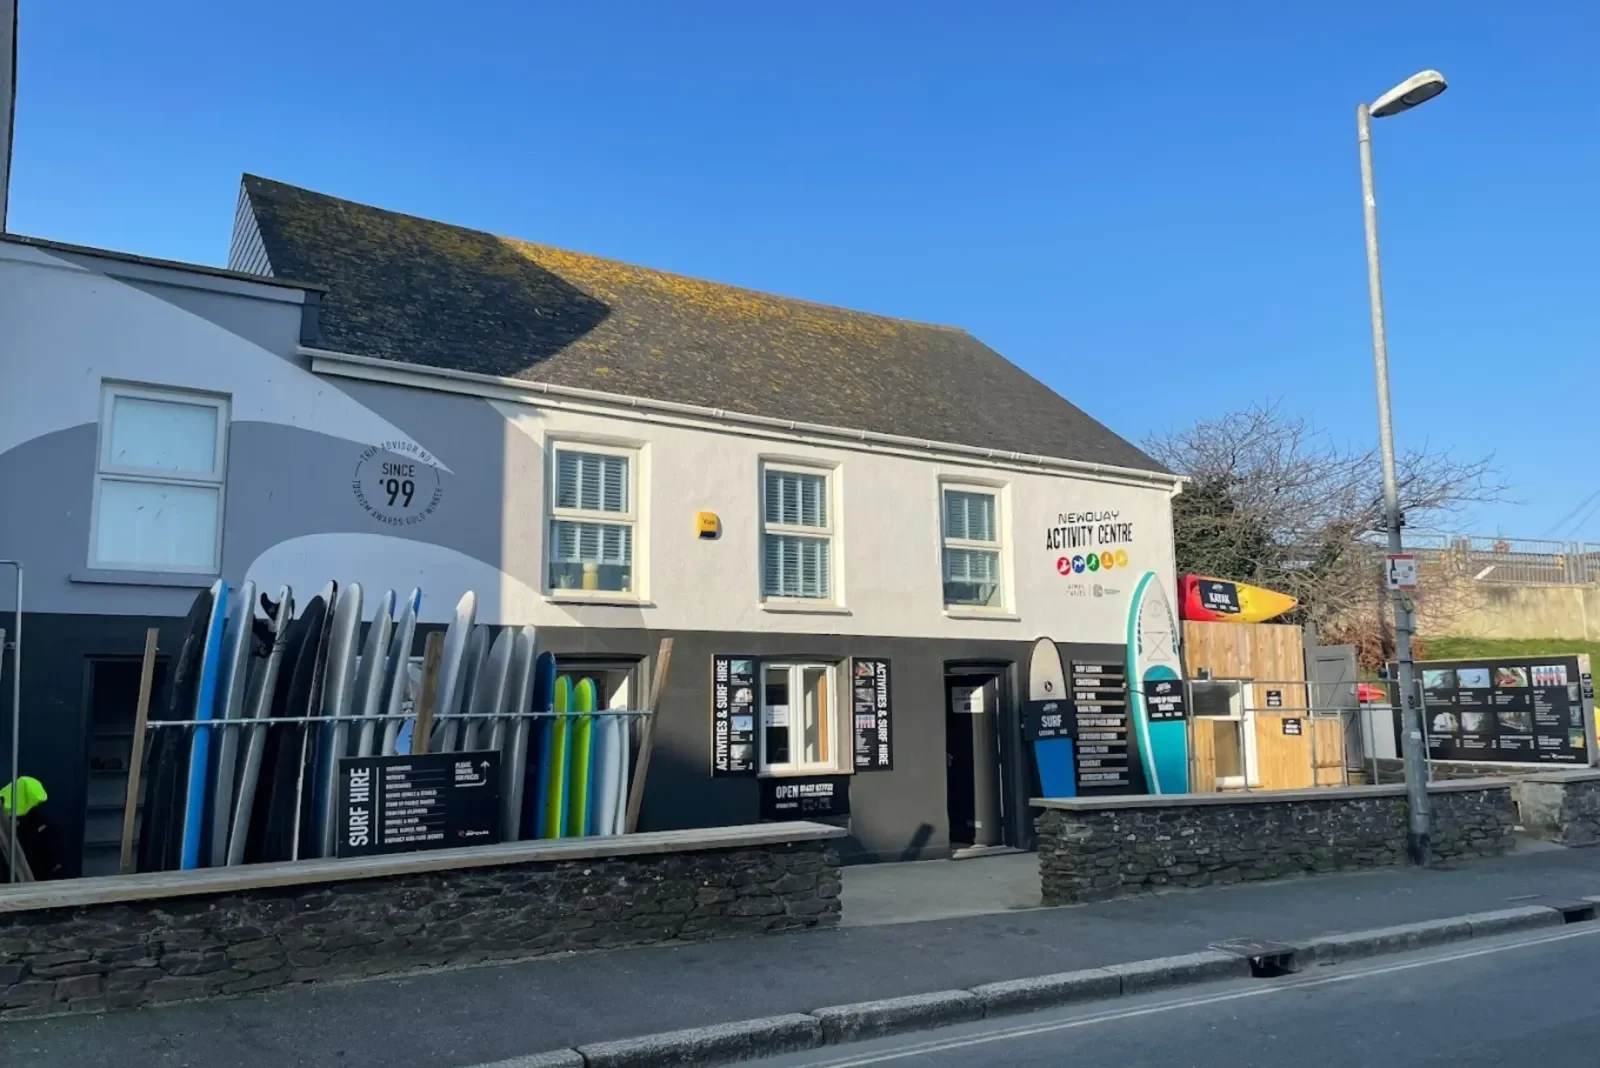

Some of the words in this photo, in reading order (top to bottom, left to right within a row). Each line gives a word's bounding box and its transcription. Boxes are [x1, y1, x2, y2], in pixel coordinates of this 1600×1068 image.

[360, 445, 379, 462] TRIP
[380, 440, 419, 454] ADVISOR
[382, 462, 416, 478] SINCE
[371, 511, 404, 526] AWARDS
[406, 512, 426, 525] GOLD
[424, 487, 443, 515] WINNER
[1058, 510, 1120, 525] NEWQUAY
[1046, 525, 1093, 551] ACTIVITY
[1098, 522, 1133, 545] CENTRE
[716, 659, 728, 682] HIRE
[716, 683, 728, 709] SURF
[876, 661, 887, 708] ACTIVITIES
[716, 710, 728, 719] &
[877, 710, 887, 718] &
[1041, 714, 1062, 728] SURF
[877, 719, 888, 743] SURF
[716, 720, 728, 771] ACTIVITIES
[878, 744, 889, 766] HIRE
[350, 767, 370, 803] HIRE
[775, 785, 799, 799] OPEN
[348, 806, 369, 847] SURF
